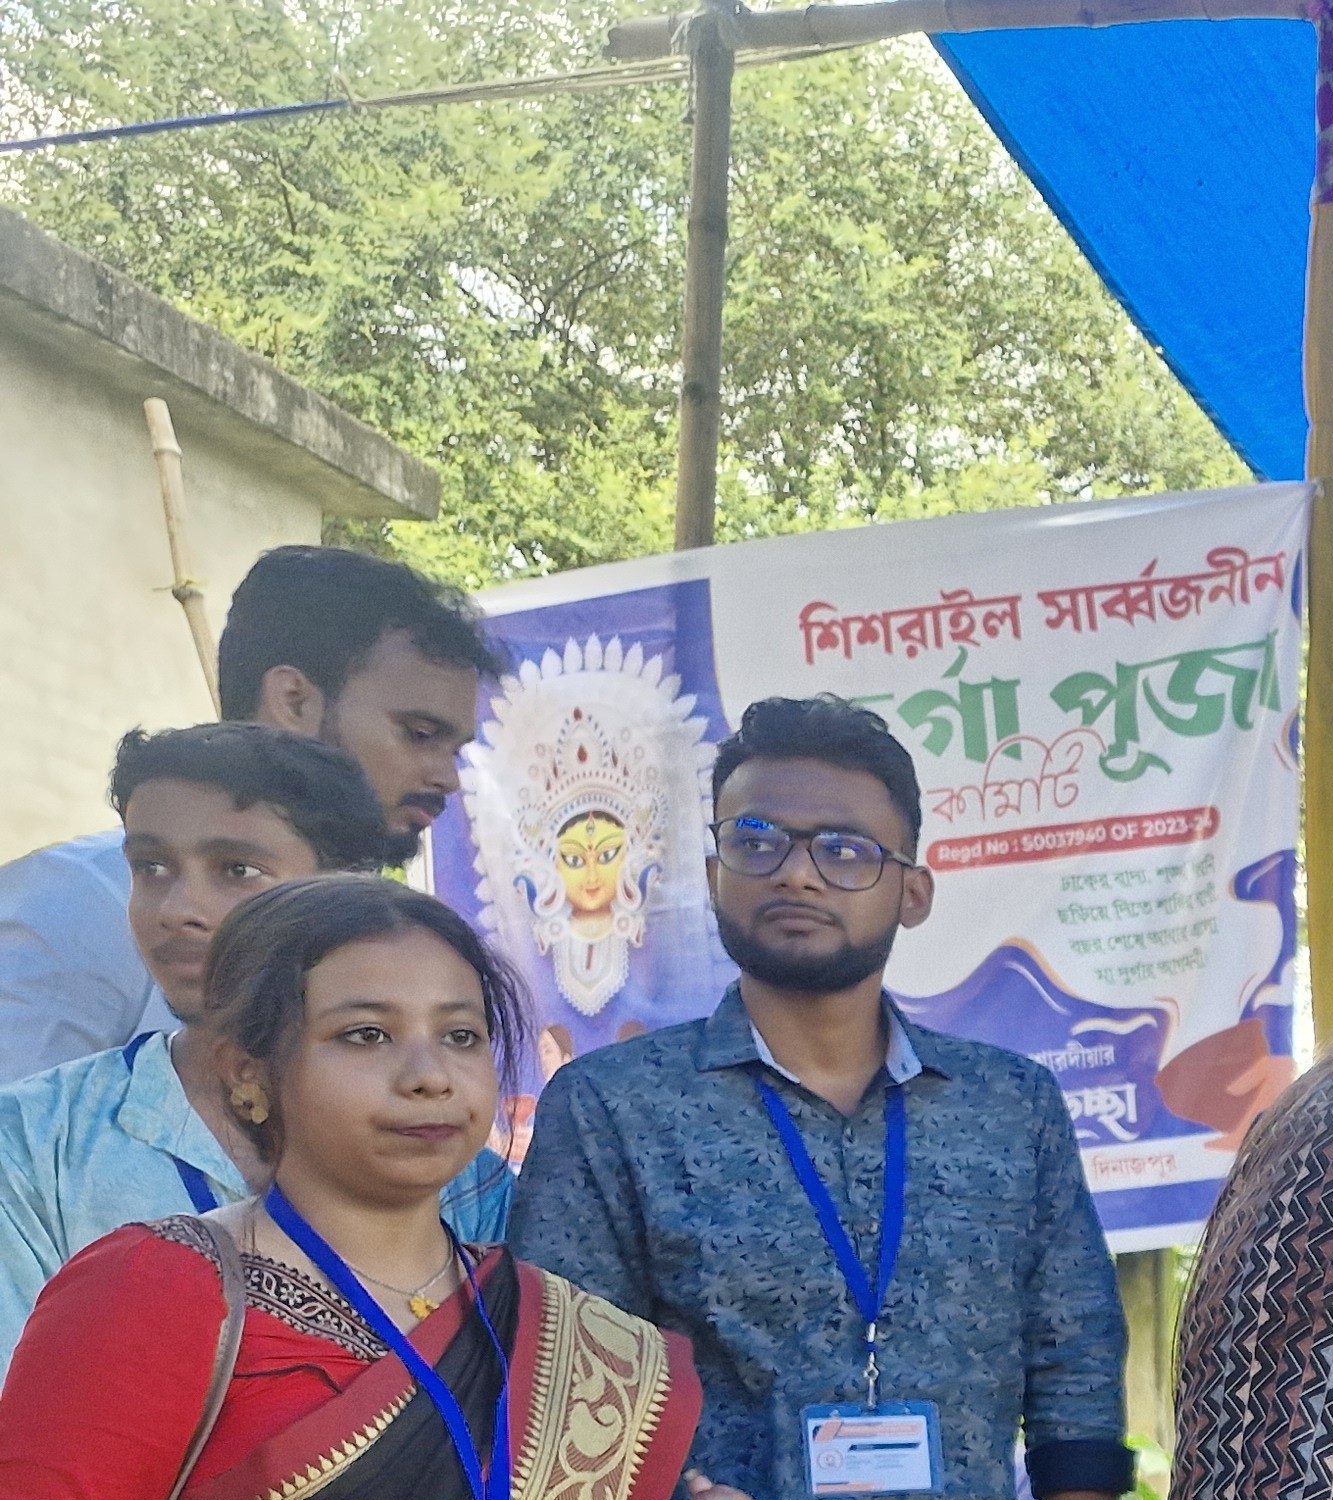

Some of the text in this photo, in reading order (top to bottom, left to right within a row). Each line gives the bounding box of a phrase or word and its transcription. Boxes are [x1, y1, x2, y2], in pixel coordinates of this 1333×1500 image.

[800, 588, 1022, 665] শিশরাইল
[859, 628, 1283, 783] র্গা পূজা
[937, 842, 982, 863] Regd
[1110, 822, 1139, 842] OF
